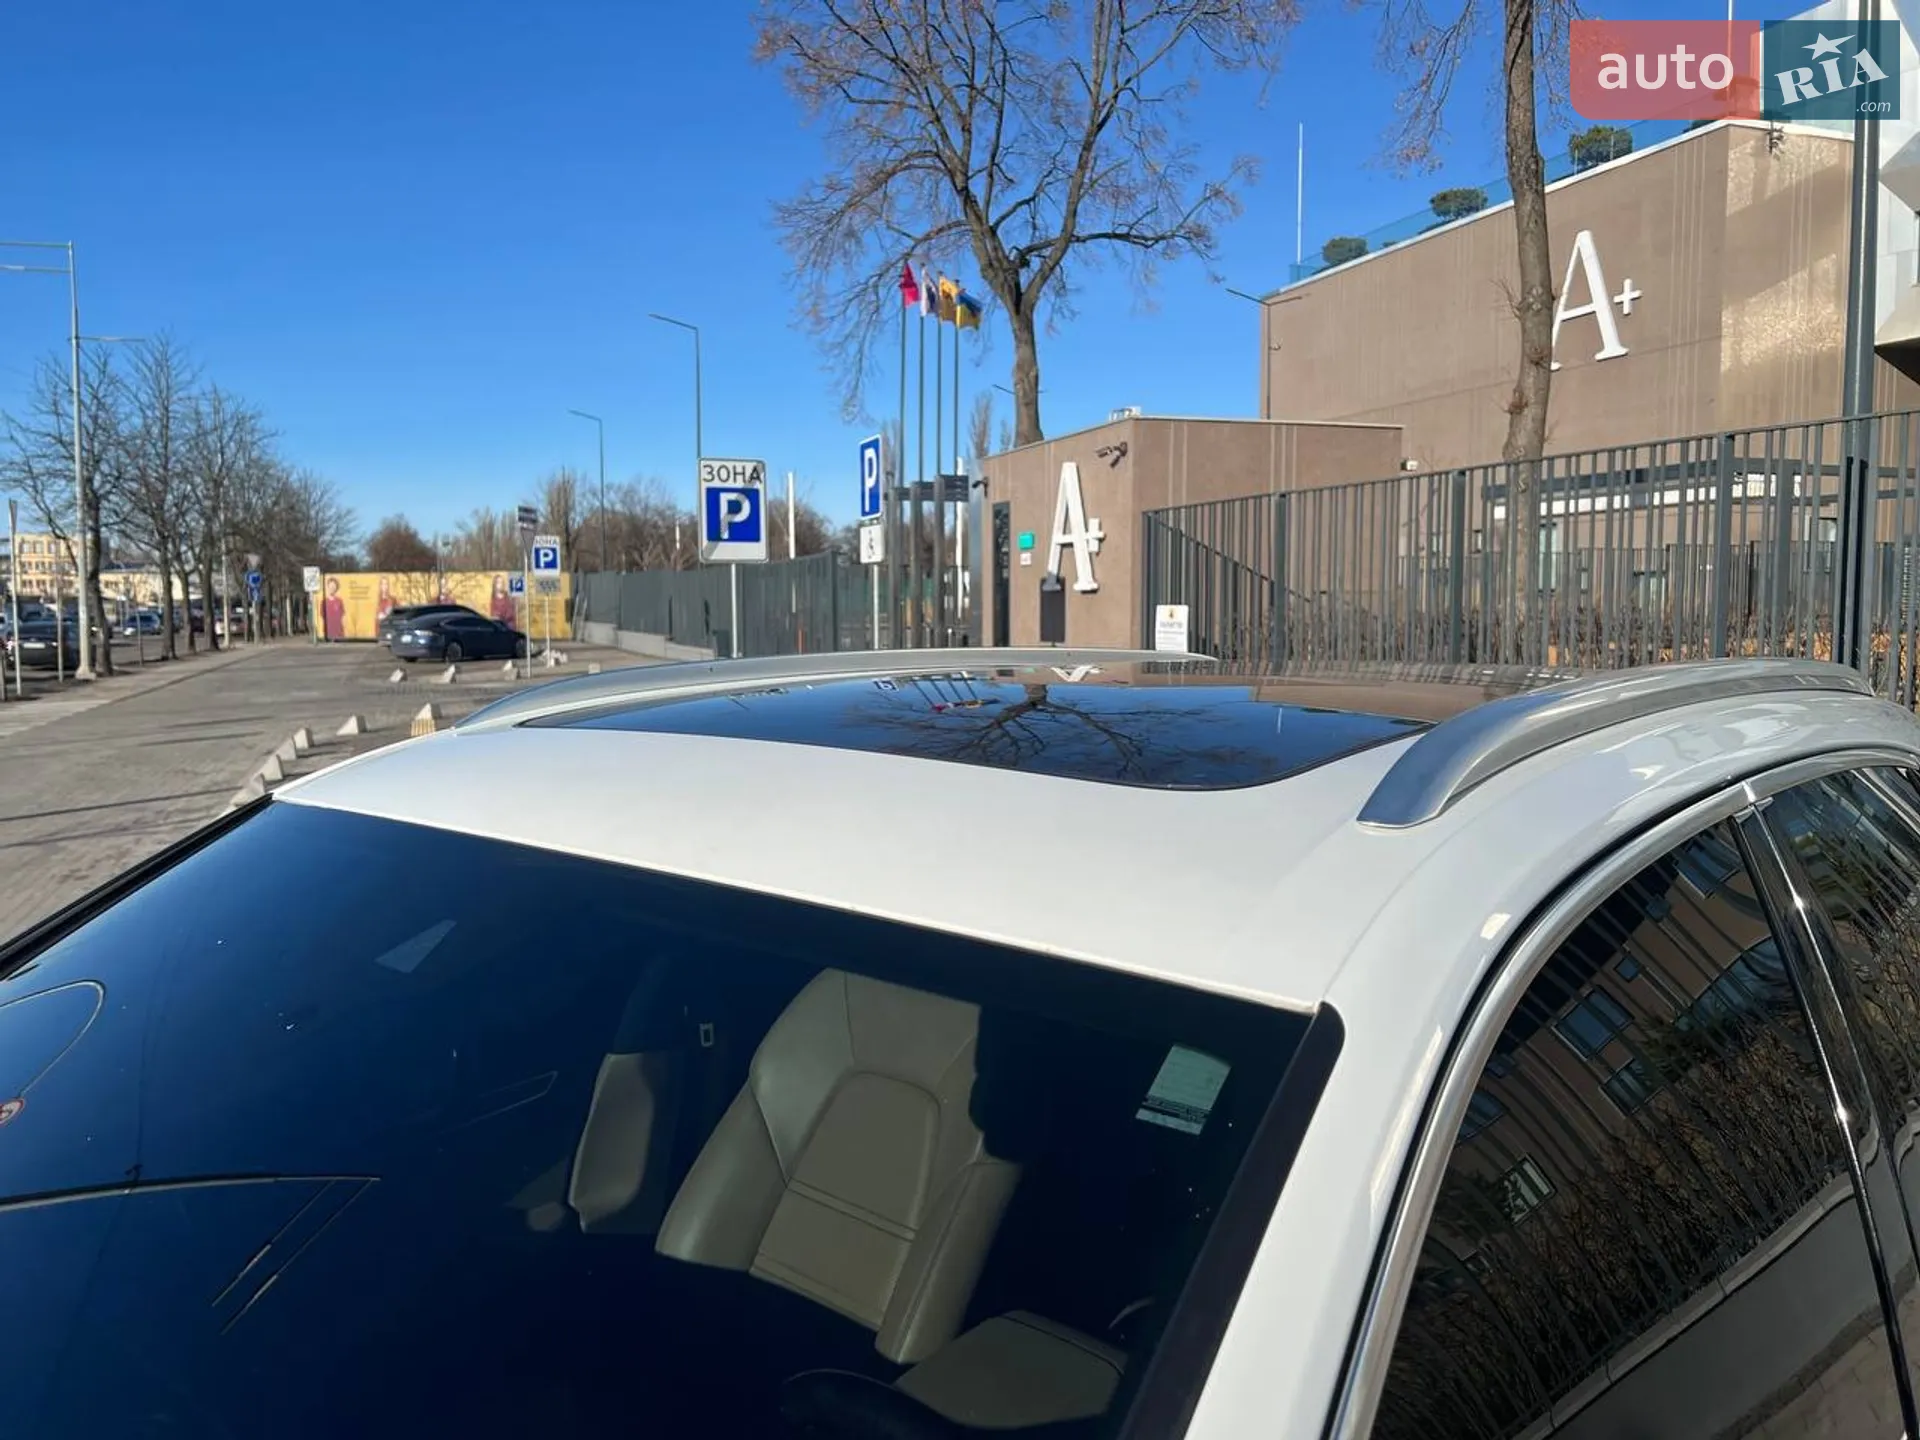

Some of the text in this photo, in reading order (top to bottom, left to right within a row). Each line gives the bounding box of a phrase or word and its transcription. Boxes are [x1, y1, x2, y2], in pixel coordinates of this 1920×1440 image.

[702, 464, 763, 484] ЗОНА
[863, 447, 878, 513] P
[719, 491, 751, 540] P
[539, 549, 554, 568] P
